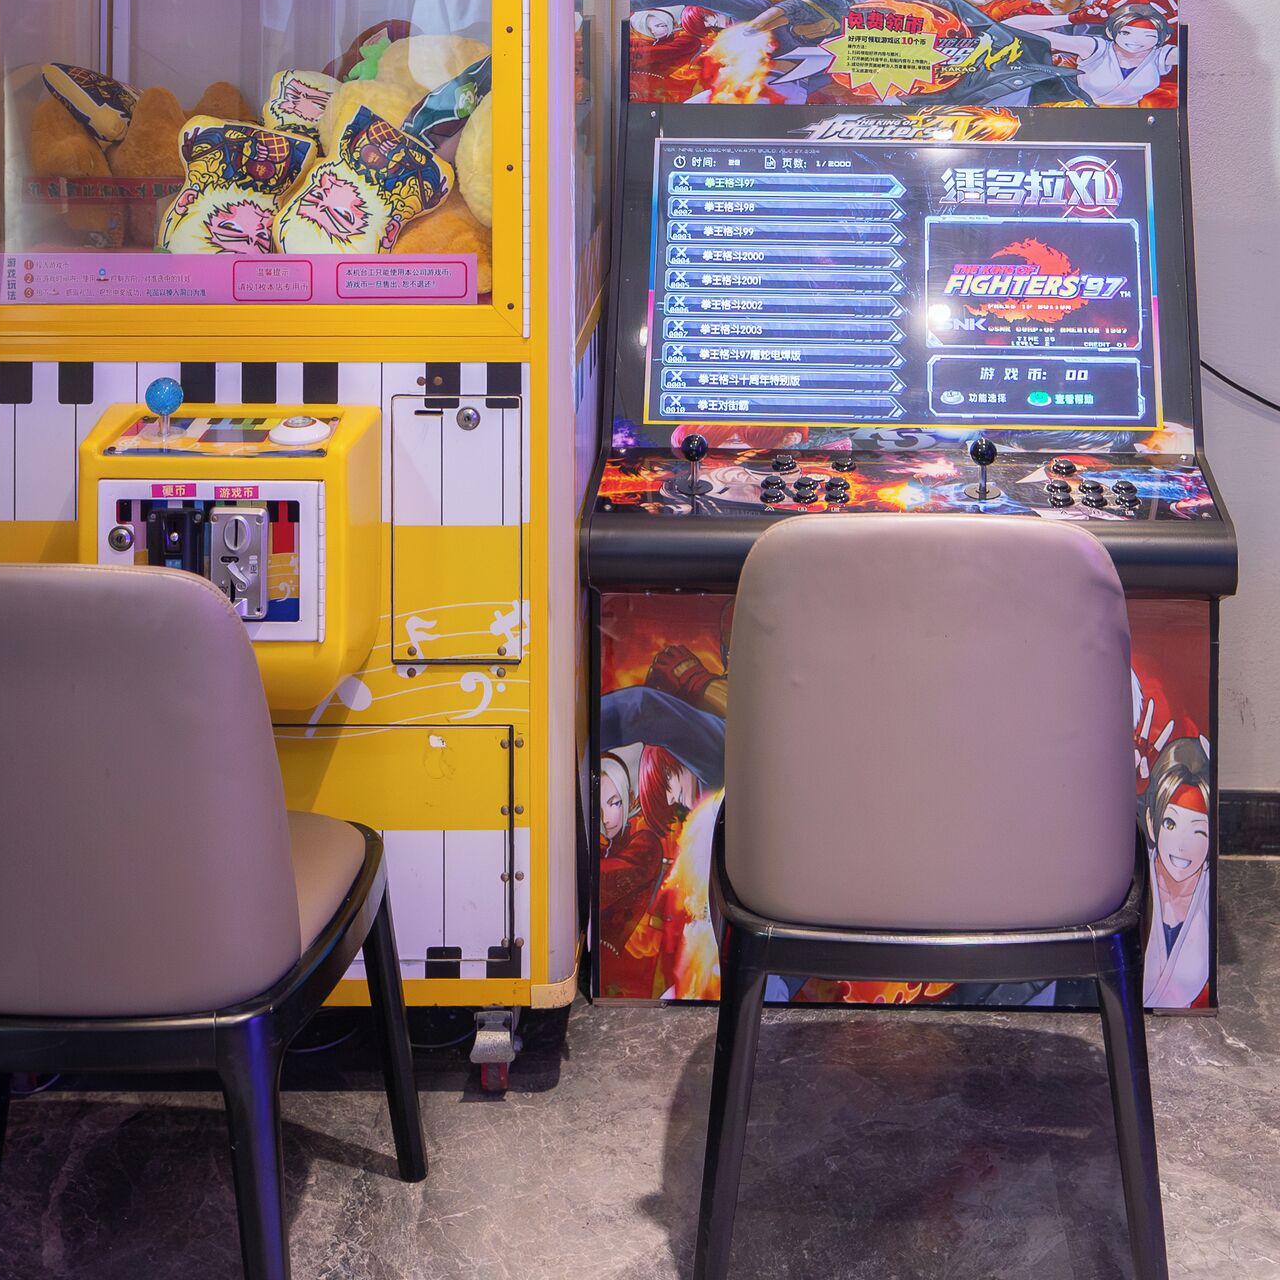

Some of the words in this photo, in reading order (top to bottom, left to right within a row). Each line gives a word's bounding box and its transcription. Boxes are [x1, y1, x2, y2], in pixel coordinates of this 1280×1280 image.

[847, 10, 924, 34] 免费领币
[968, 393, 1007, 404] 功能选择
[162, 485, 186, 497] 硬币
[219, 487, 253, 498] 游戏币
